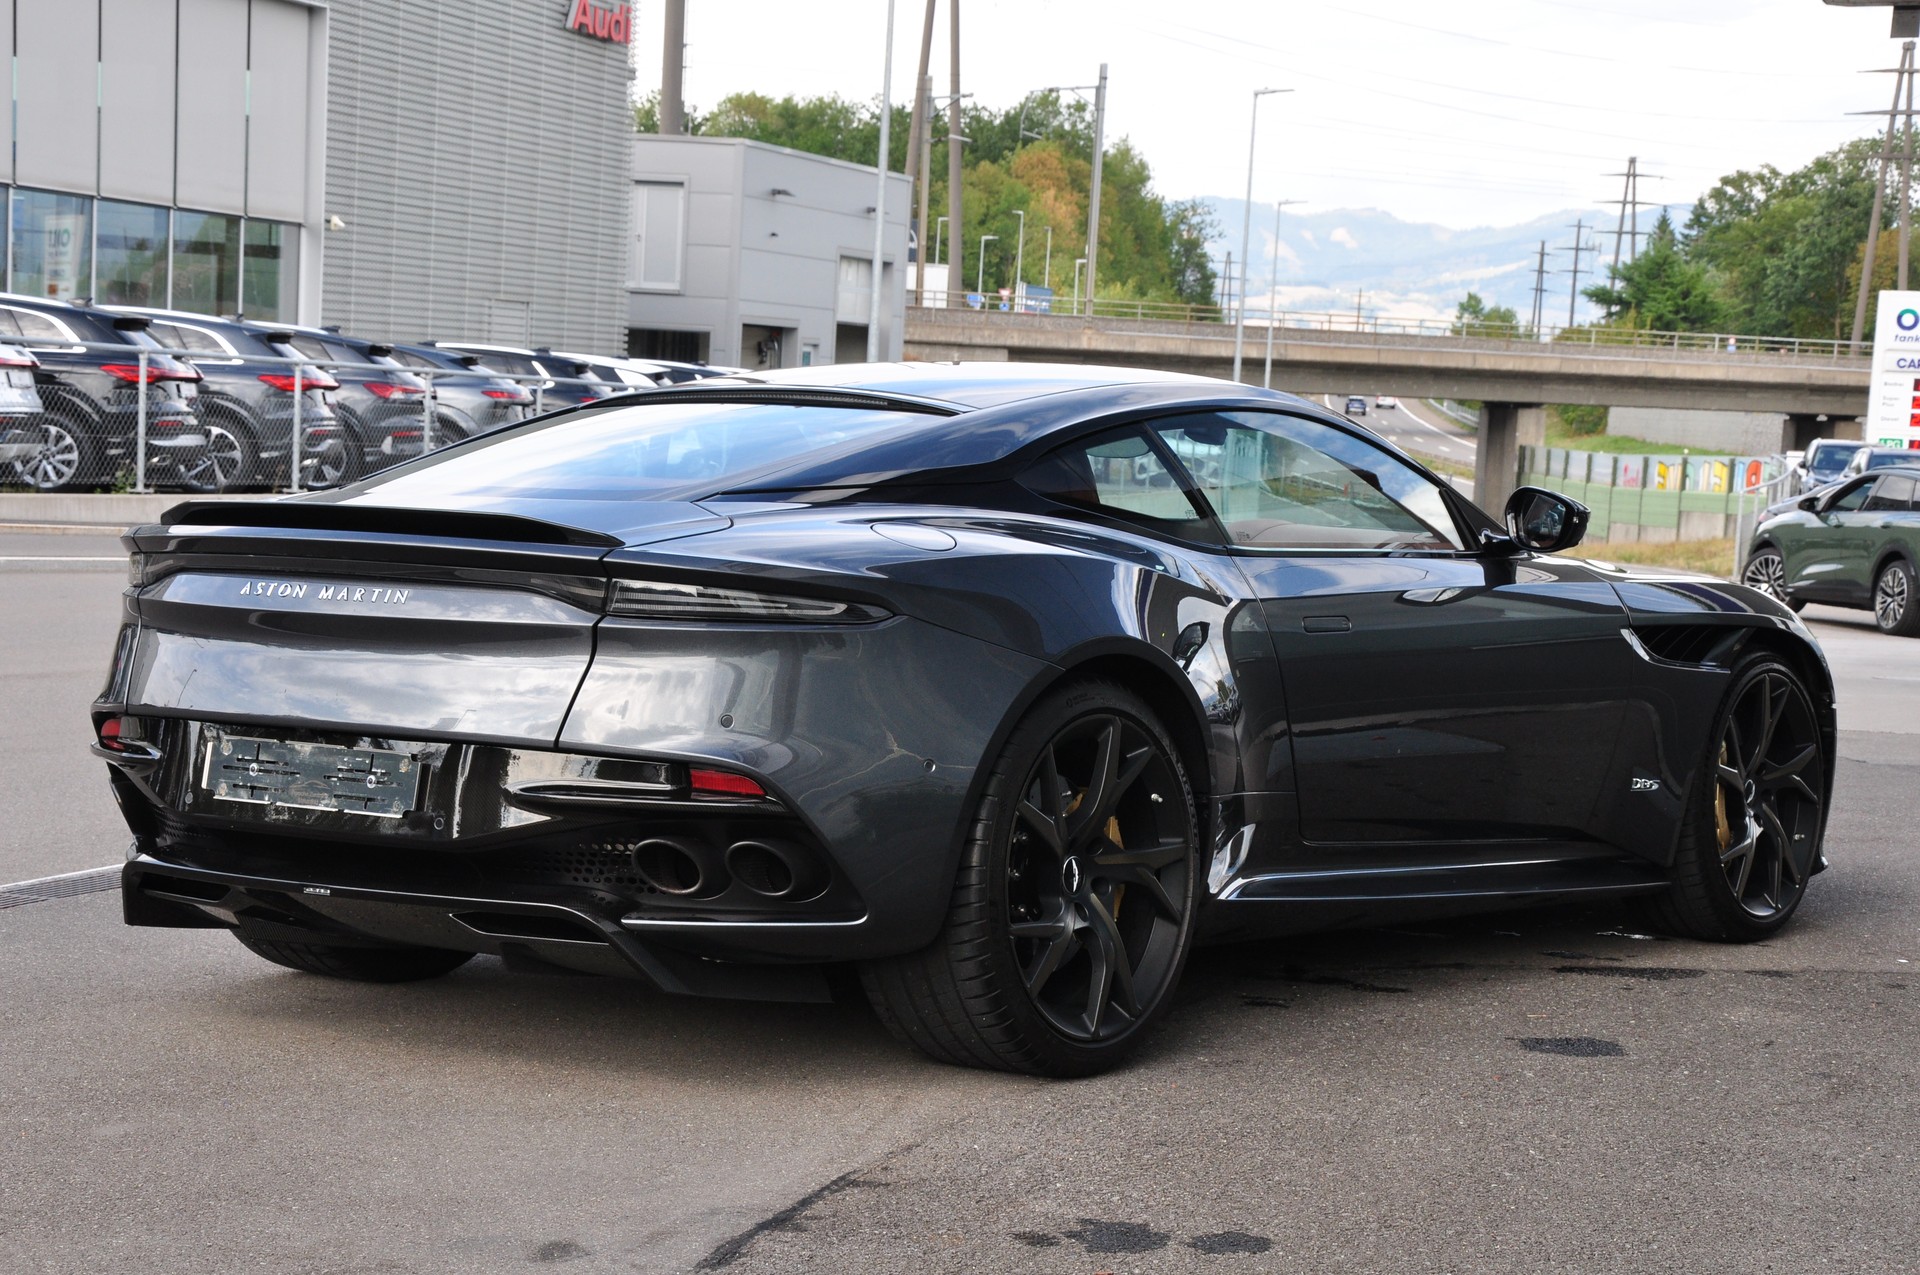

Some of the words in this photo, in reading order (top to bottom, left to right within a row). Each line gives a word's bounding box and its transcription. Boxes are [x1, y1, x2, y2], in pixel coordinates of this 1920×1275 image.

[573, 0, 632, 44] Audi
[240, 581, 307, 599] ASTON
[318, 586, 410, 604] MARTIN
